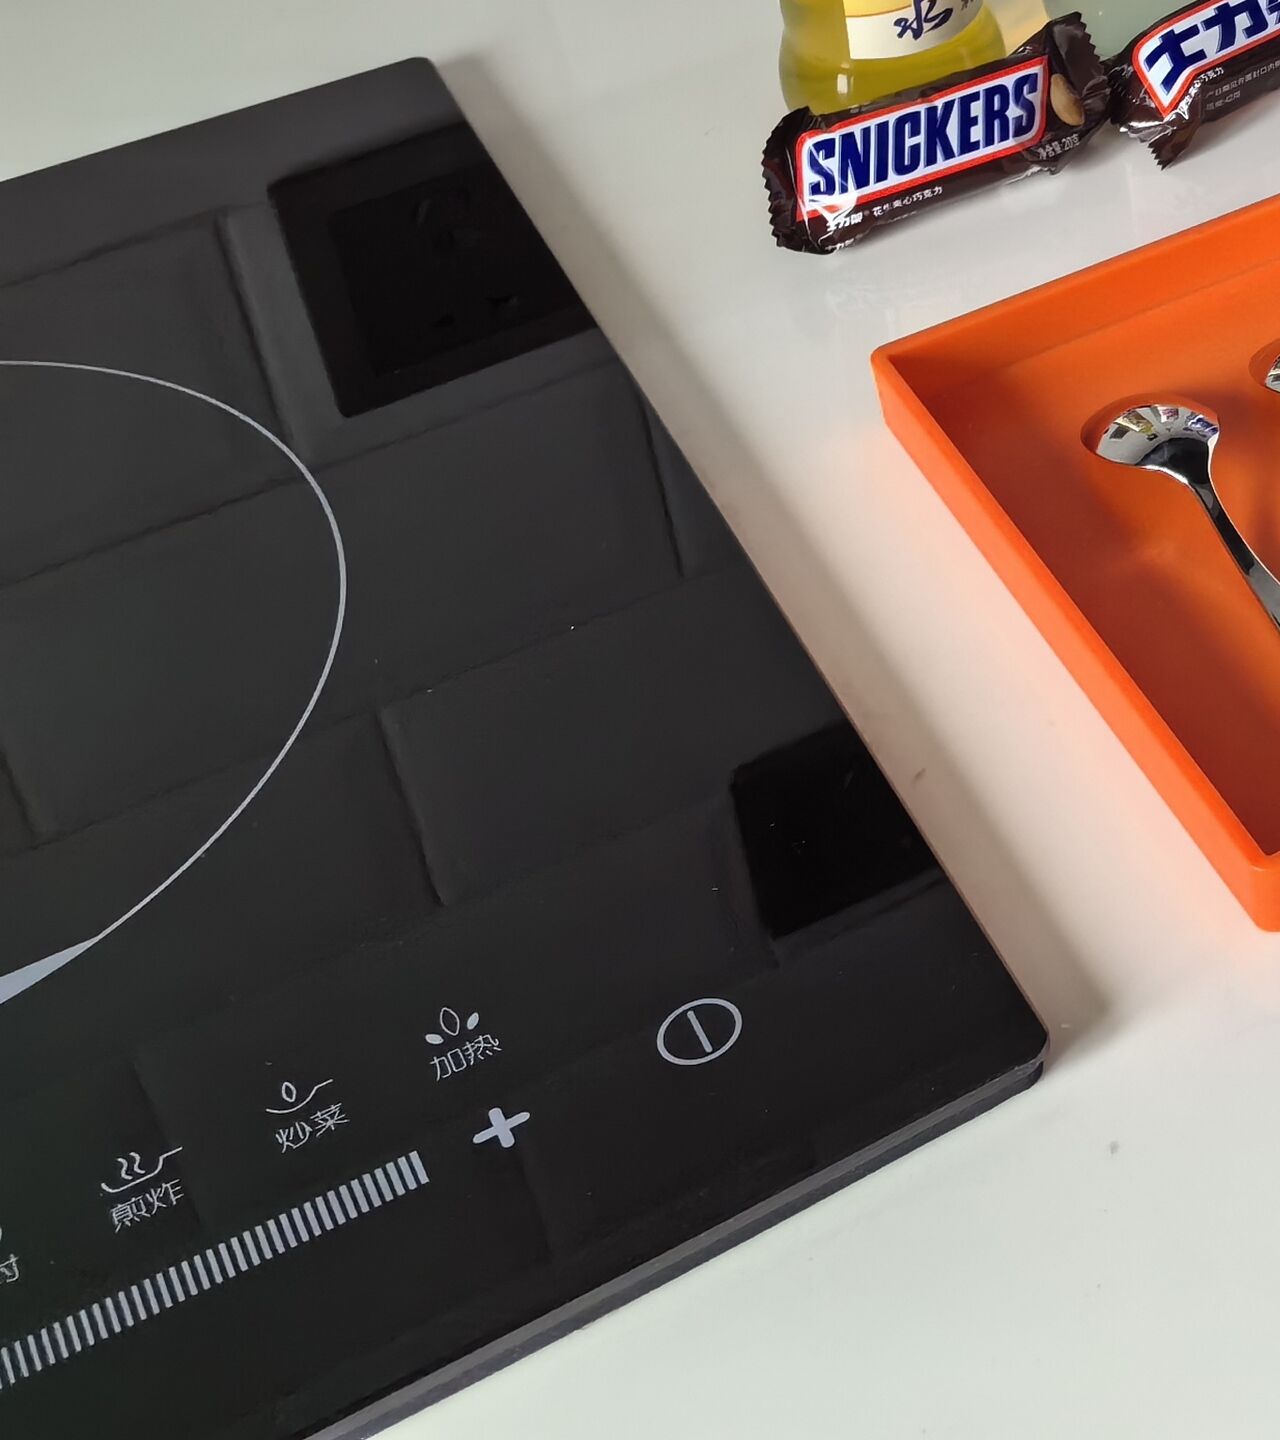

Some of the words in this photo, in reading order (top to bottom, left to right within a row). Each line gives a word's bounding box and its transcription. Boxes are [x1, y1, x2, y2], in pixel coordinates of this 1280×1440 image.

[806, 71, 1039, 199] SNICKERS
[430, 1034, 502, 1082] 加热
[275, 1103, 350, 1154] 炒菜
[110, 1179, 185, 1234] 煎炸
